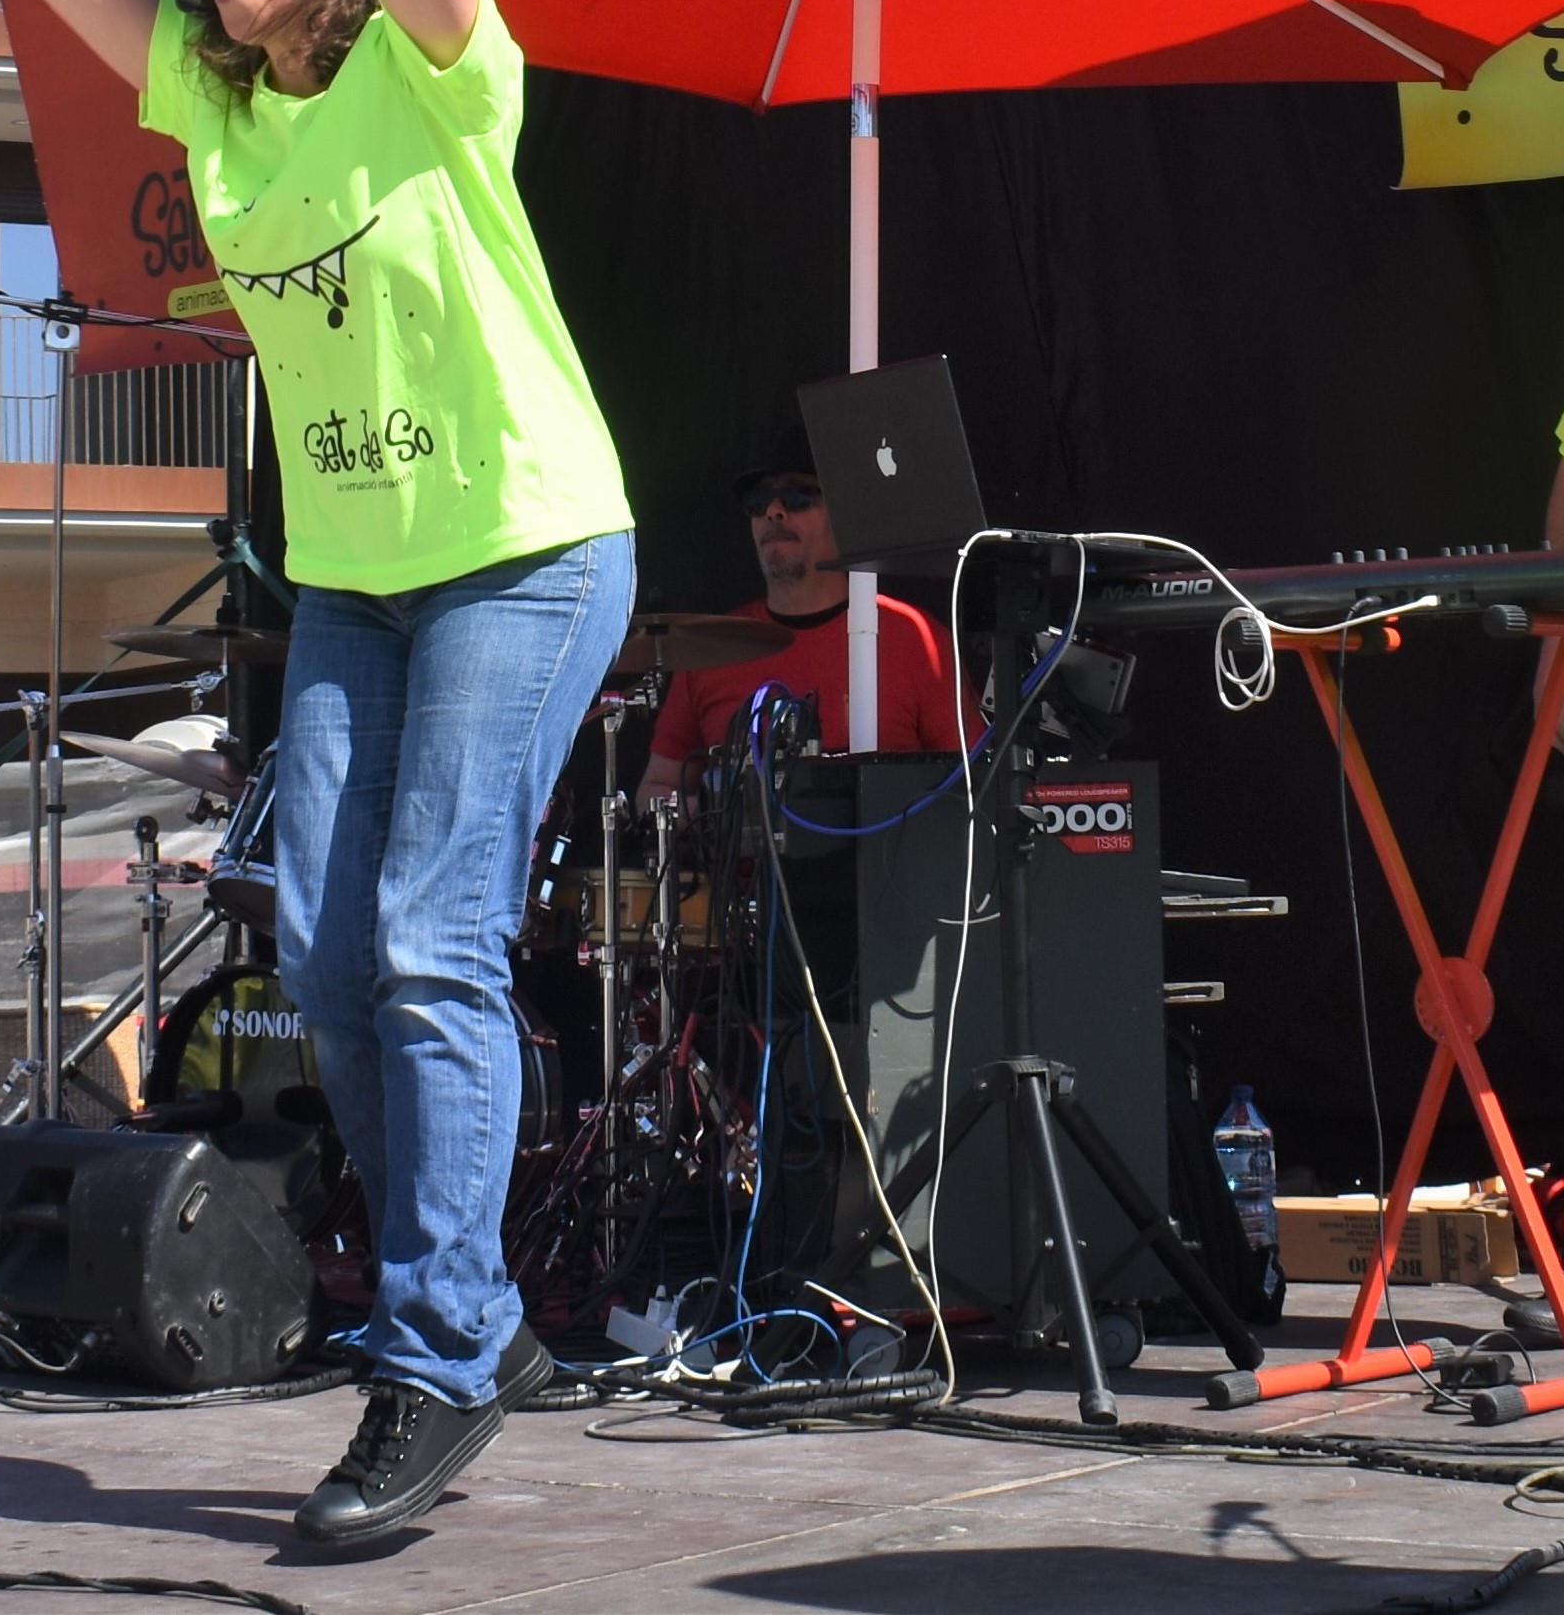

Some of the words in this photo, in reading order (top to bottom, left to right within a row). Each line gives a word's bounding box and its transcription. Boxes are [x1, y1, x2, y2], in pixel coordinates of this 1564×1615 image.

[304, 409, 356, 473] Set
[360, 409, 383, 473] de
[385, 408, 434, 462] So
[1094, 835, 1131, 850] TS315
[232, 1010, 306, 1039] SONOR
